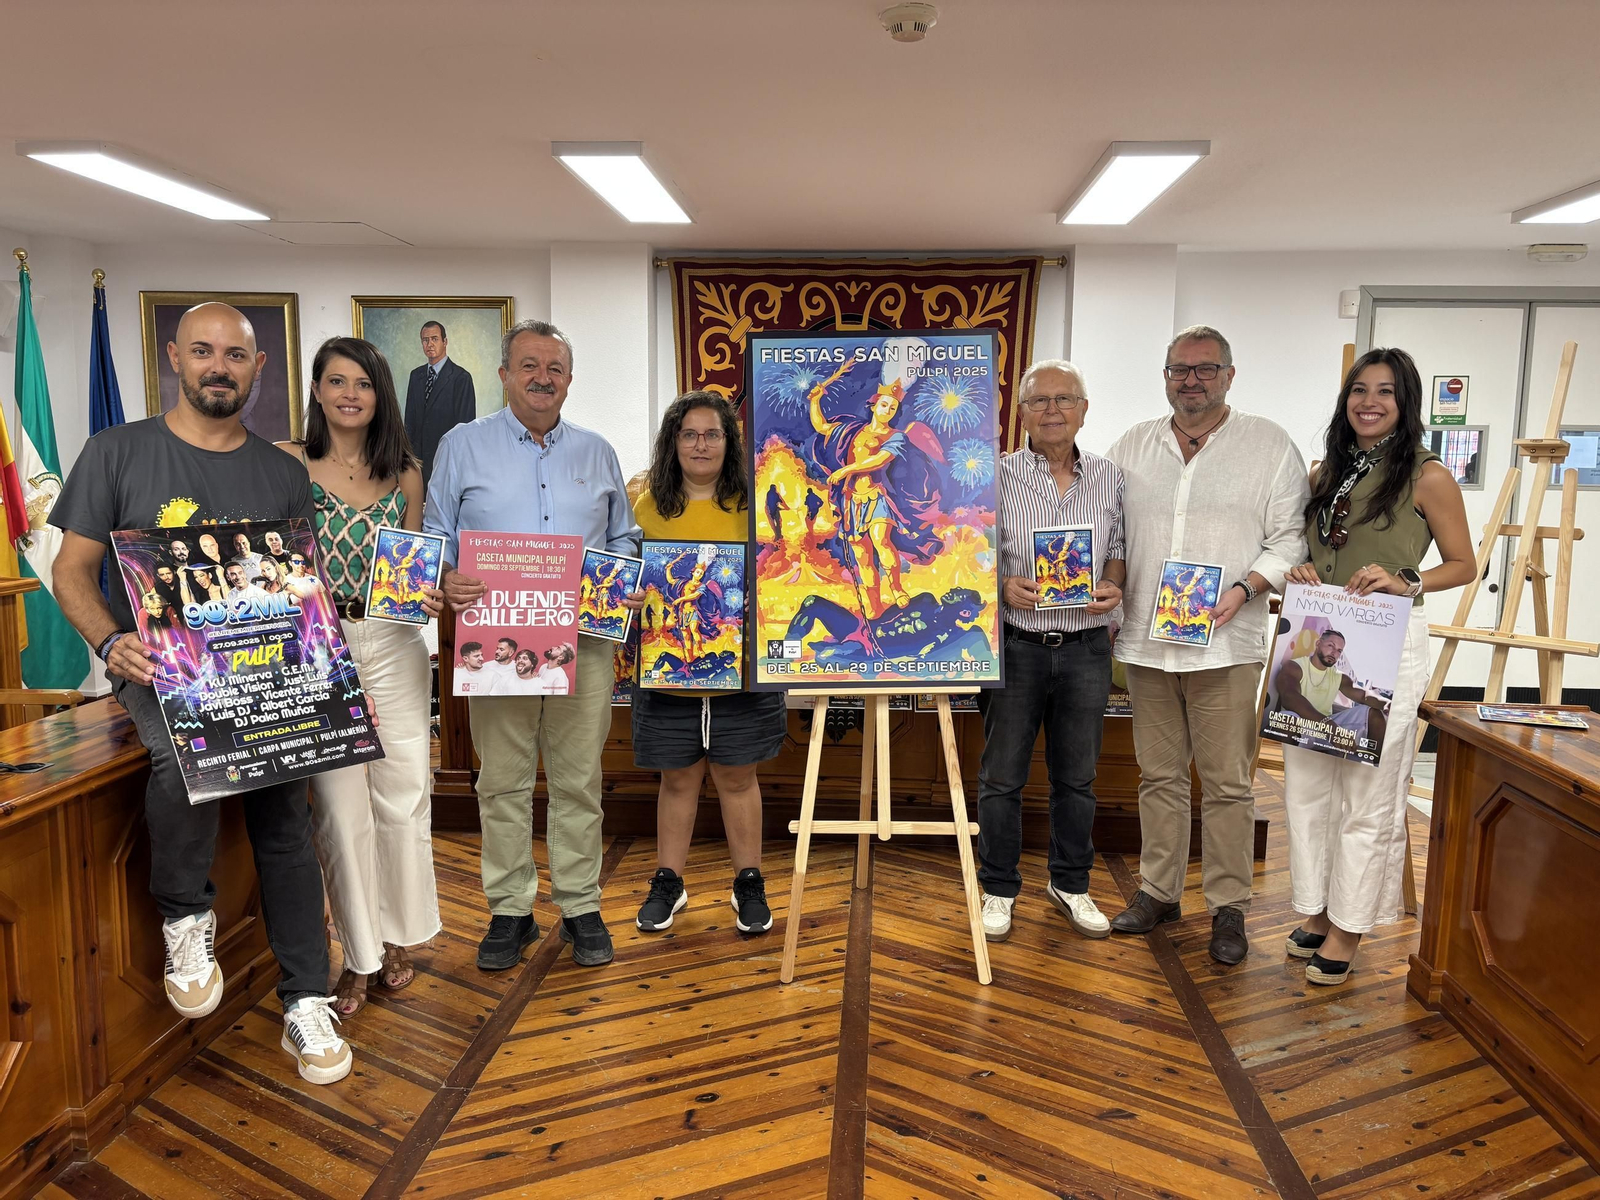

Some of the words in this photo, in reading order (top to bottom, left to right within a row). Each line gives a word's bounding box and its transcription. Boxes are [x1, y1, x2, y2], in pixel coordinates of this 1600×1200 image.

[760, 347, 846, 363] FIESTAS
[854, 347, 899, 362] SAN
[907, 345, 989, 361] MIGUEL
[954, 366, 988, 377] 2025
[469, 538, 503, 548] FIESTAS
[506, 539, 523, 548] SAN
[525, 540, 556, 549] MIGUEL
[646, 546, 682, 554] FIESTAS
[476, 552, 504, 563] CASETA
[505, 554, 544, 564] MUNICIPAL
[546, 553, 566, 565] PULPÍ
[509, 564, 540, 572] SEPTIEMBRE
[491, 590, 576, 608] DUENDE
[1303, 589, 1331, 600] FIESTAS
[1332, 594, 1347, 603] SAN
[461, 608, 575, 627] CALLEJERO
[1295, 597, 1334, 615] NYNO
[1336, 604, 1396, 626] VARGAS
[212, 637, 261, 650] 27.09.2025
[268, 632, 294, 641] 00:30
[232, 639, 285, 673] PULPÍ
[209, 677, 226, 689] KU
[228, 670, 273, 686] Minerva
[281, 663, 314, 677] G.E.M.
[766, 662, 796, 675] DEL
[799, 662, 818, 674] 25
[824, 662, 844, 673] AL
[849, 661, 868, 673] 29
[873, 661, 893, 673] DE
[898, 661, 992, 673] SEPTIEMBRE
[199, 686, 240, 701] Double
[241, 680, 275, 694] Vision
[283, 675, 306, 687] Just
[307, 671, 329, 682] Luis
[199, 699, 222, 713] Javi
[225, 695, 254, 708] Boss
[261, 686, 302, 701] Vicente
[303, 680, 334, 693] Ferrer
[210, 708, 236, 721] Luis
[238, 704, 251, 716] DJ
[260, 699, 294, 712] Albert
[234, 715, 249, 728] DJ
[251, 711, 280, 725] Pako
[281, 704, 317, 719] Muñoz
[243, 725, 292, 742] ENTRADA
[293, 720, 321, 733] LIBRE
[1268, 710, 1295, 725] CASETA
[1296, 717, 1334, 735] MUNICIPAL
[1335, 727, 1358, 740] PULPÍ
[1269, 720, 1289, 731] VIERNES
[1289, 725, 1297, 733] 26
[1297, 727, 1328, 741] SEPTIEMBRE
[1333, 736, 1348, 746] 23:00
[197, 754, 228, 769] RECINTO
[228, 749, 252, 763] FERIAL
[258, 743, 281, 755] CARPA
[281, 736, 315, 751] MUNICIPAL
[320, 728, 338, 741] PULPÍ
